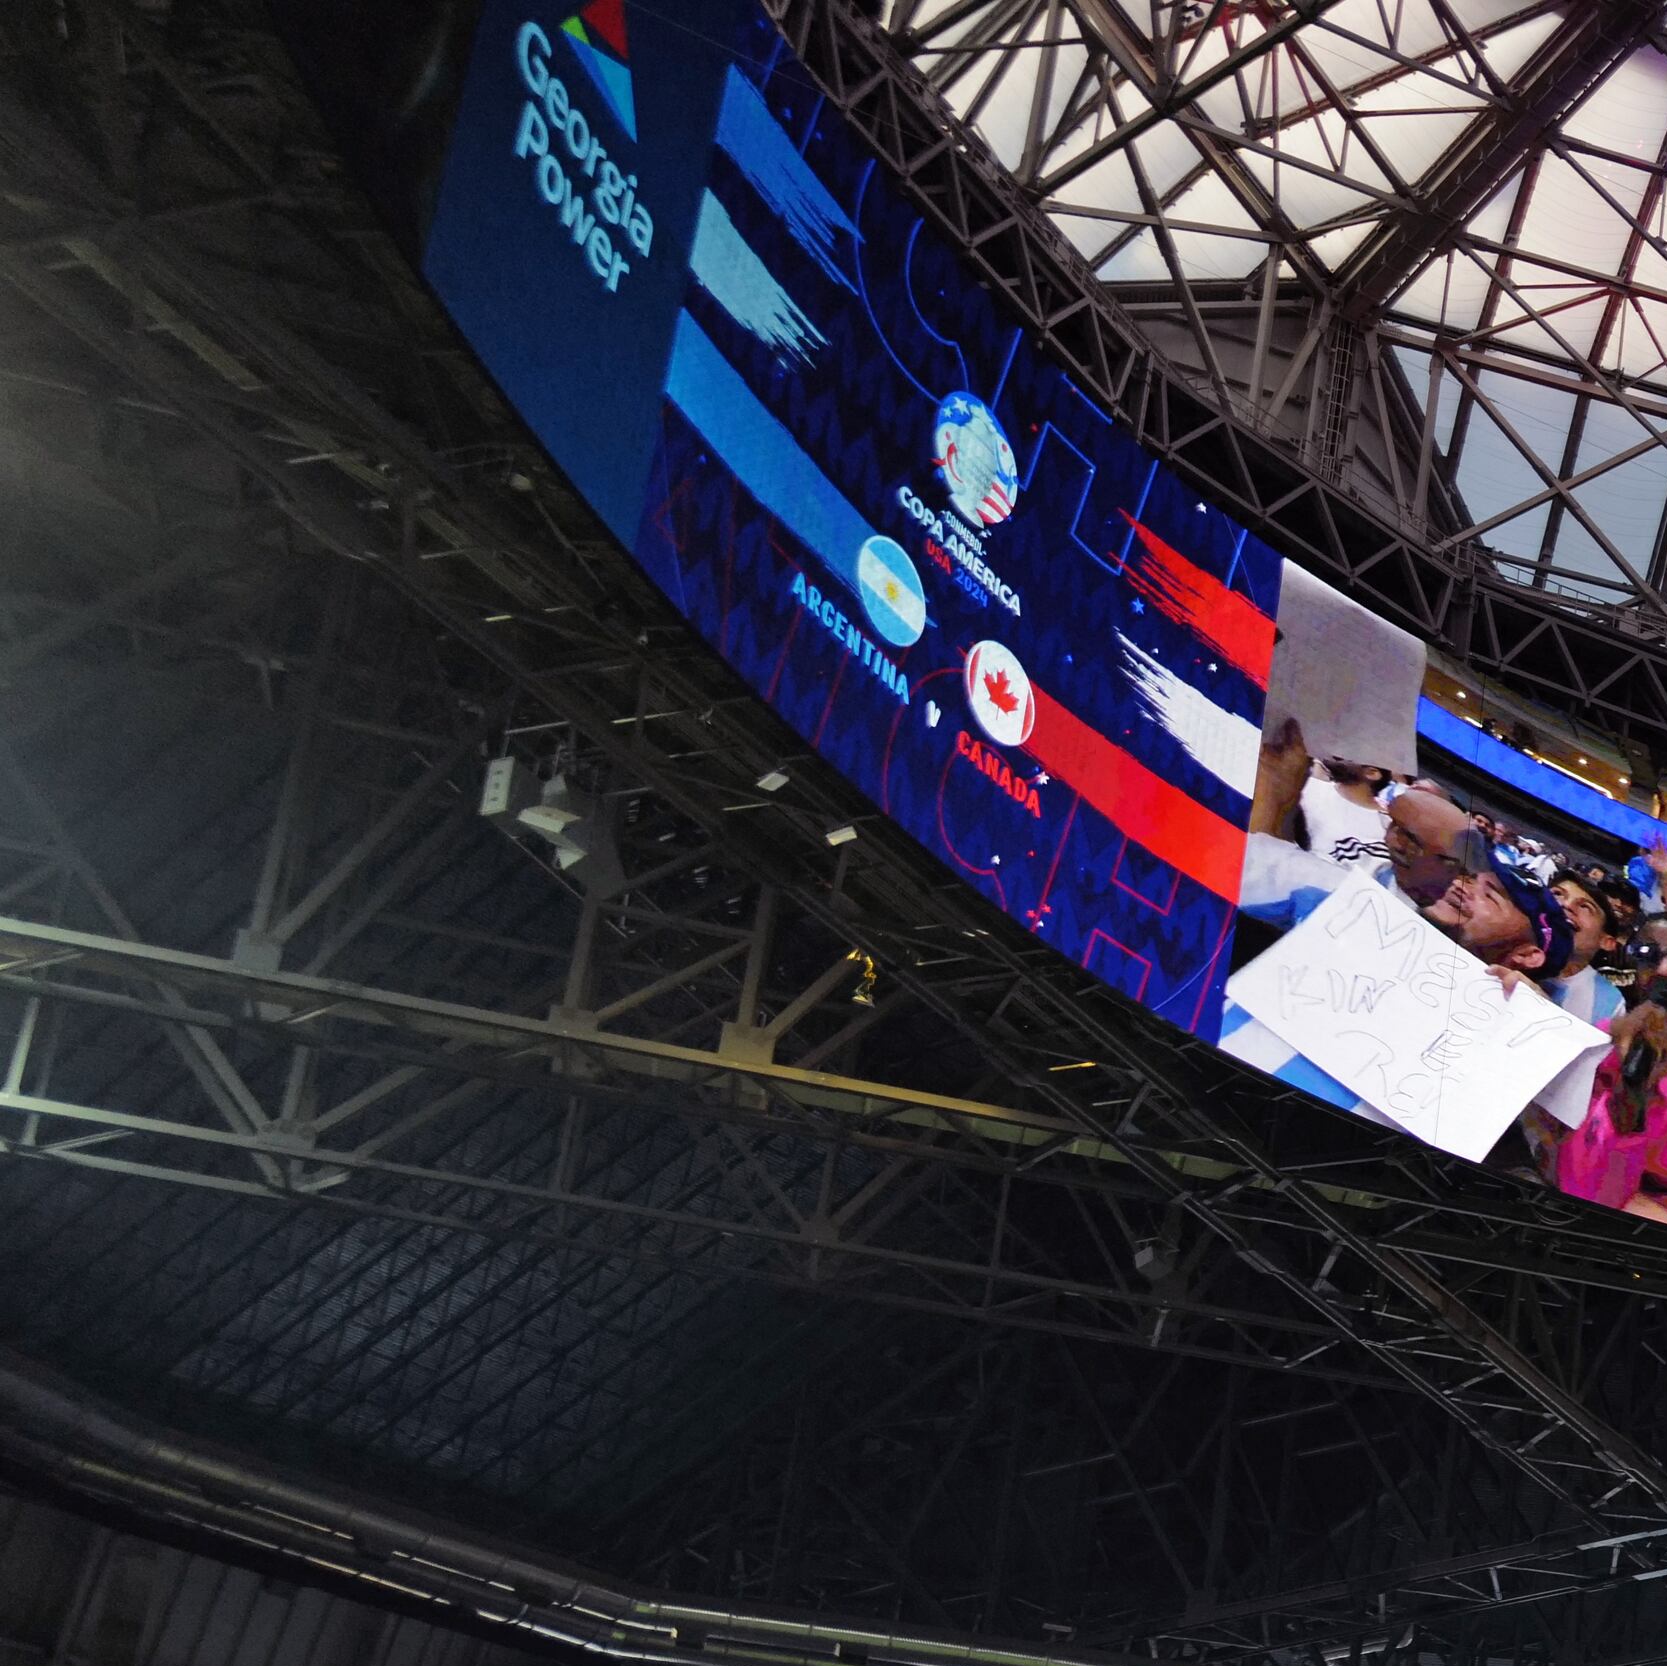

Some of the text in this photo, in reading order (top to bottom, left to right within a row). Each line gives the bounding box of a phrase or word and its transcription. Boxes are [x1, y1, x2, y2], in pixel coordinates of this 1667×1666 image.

[514, 100, 630, 293] Power
[516, 20, 654, 258] Georgia
[899, 484, 1022, 617] COPA AMERICA
[926, 537, 989, 608] USA 2024
[791, 570, 911, 706] ARGENTINA
[957, 729, 1042, 818] CANADA
